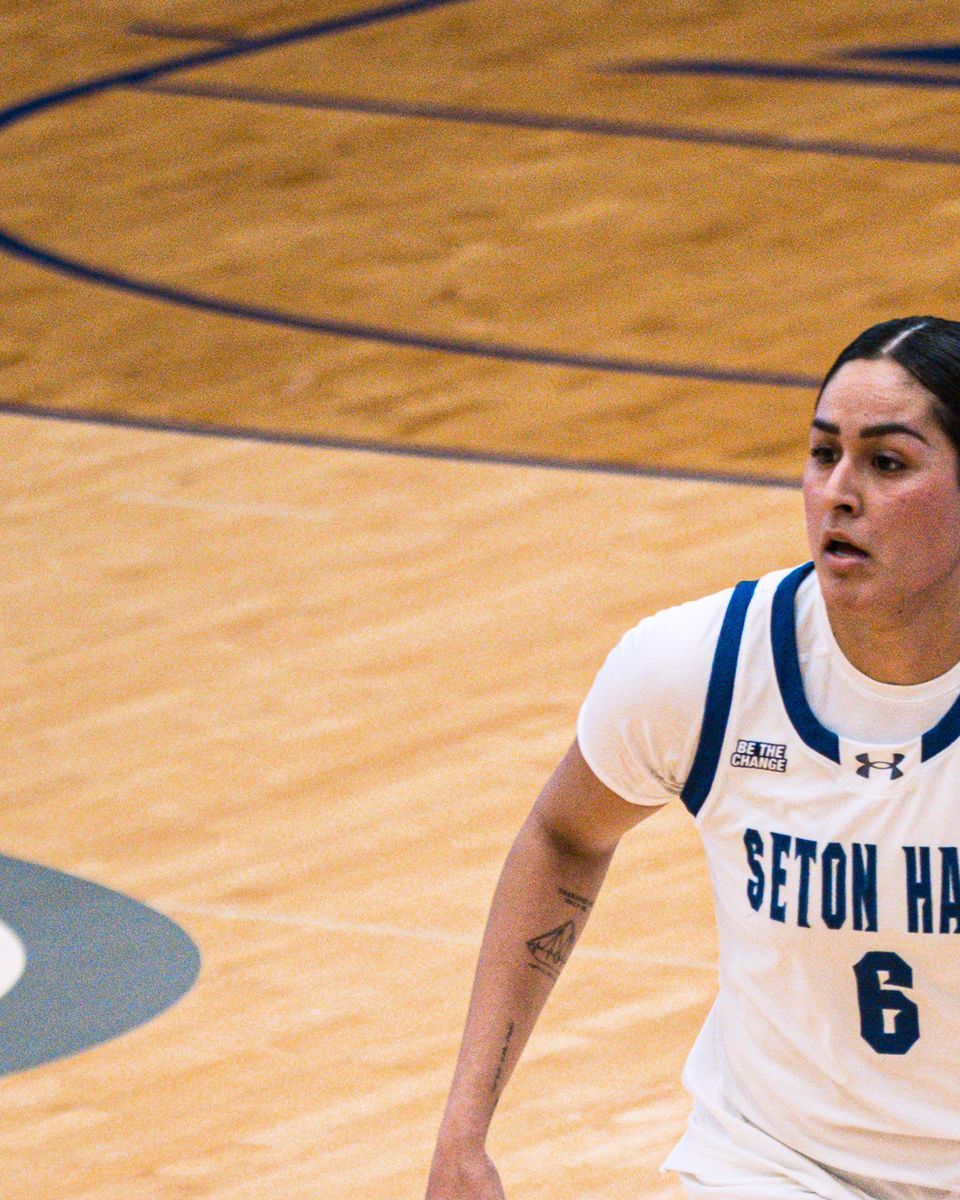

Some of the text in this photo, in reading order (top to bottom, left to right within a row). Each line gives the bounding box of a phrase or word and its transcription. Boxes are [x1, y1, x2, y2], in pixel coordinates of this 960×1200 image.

[731, 753, 786, 771] CHANGE
[737, 740, 785, 758] BE THE
[743, 828, 878, 932] SETON
[852, 951, 920, 1055] 6
